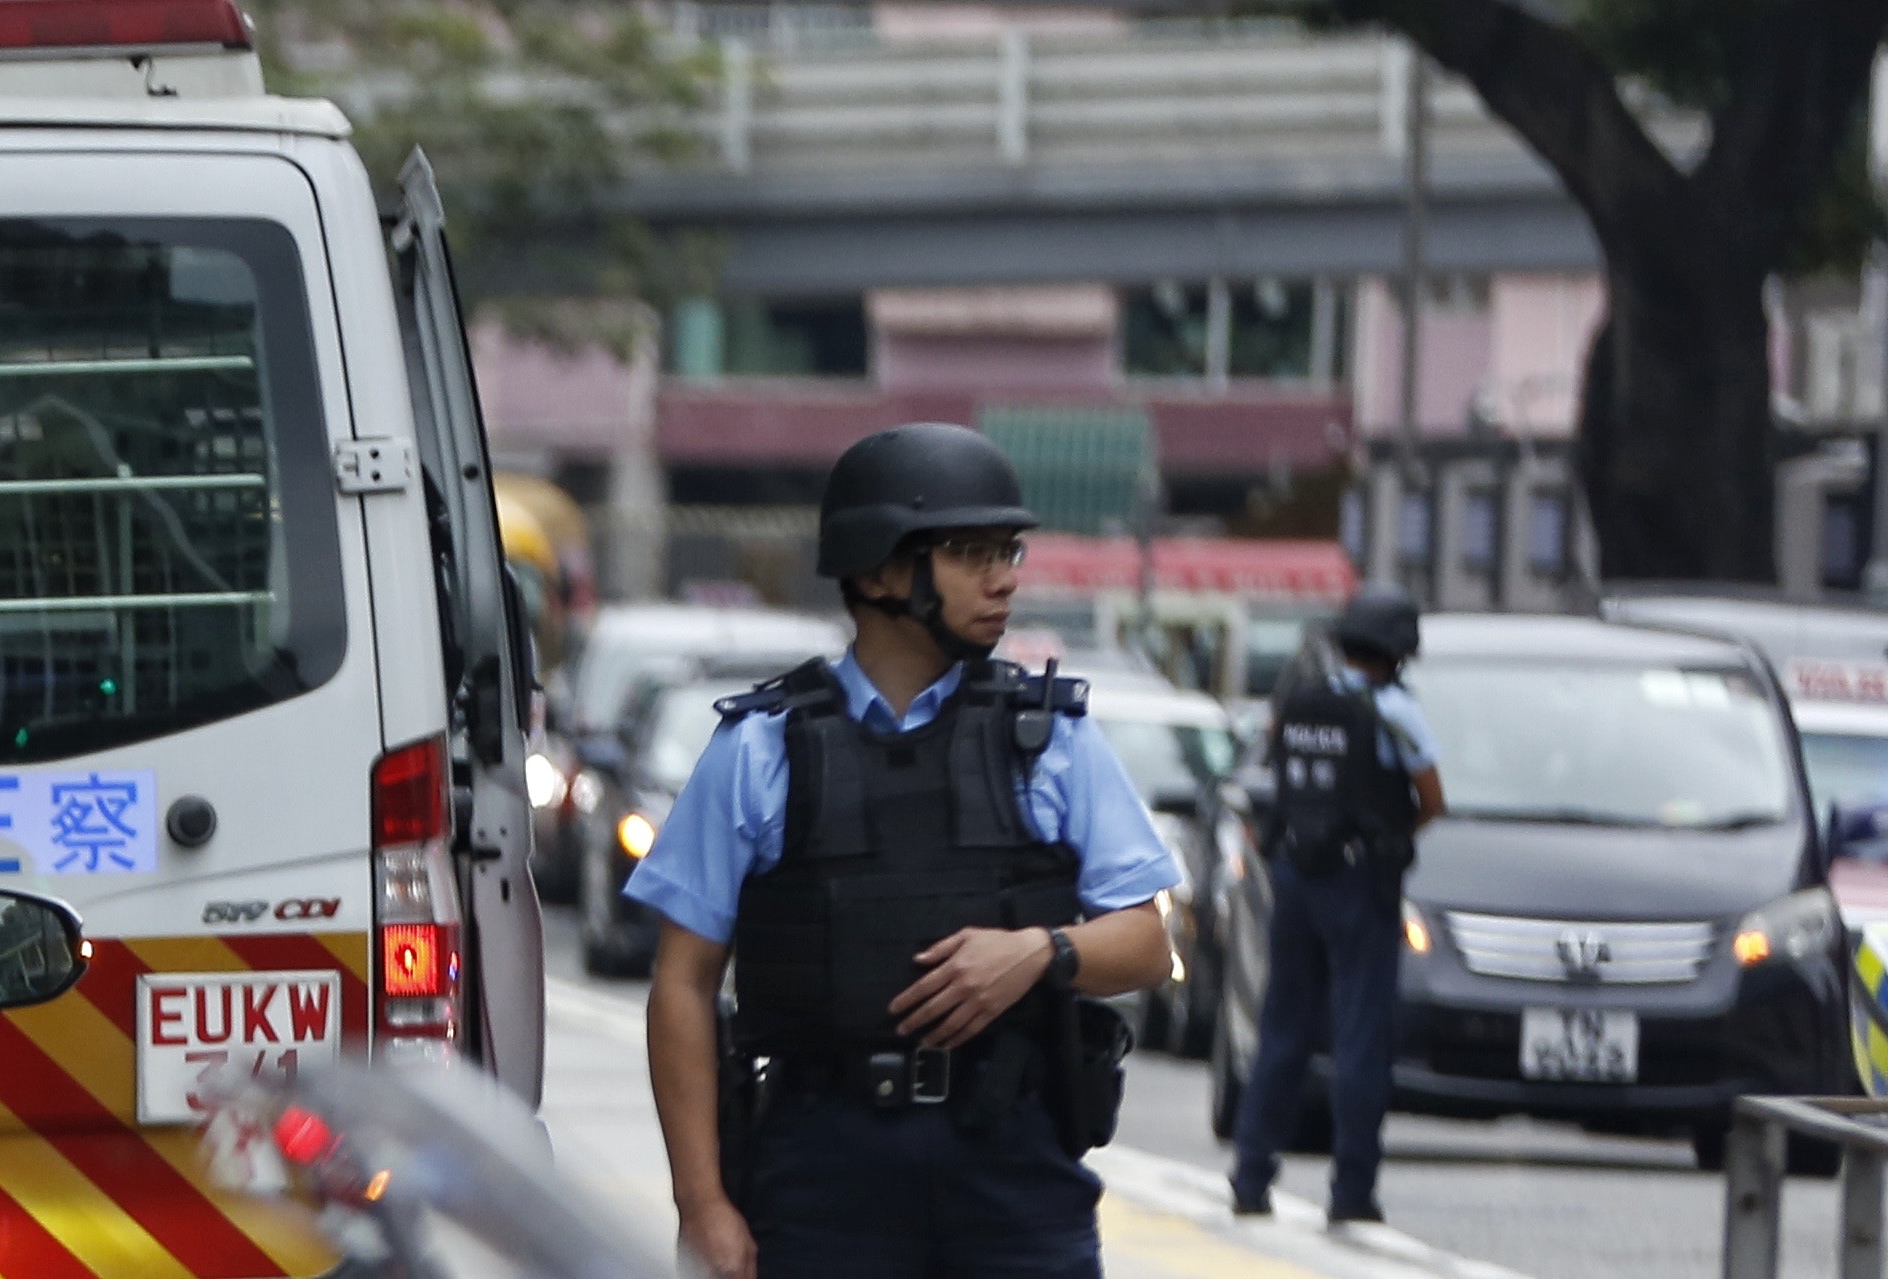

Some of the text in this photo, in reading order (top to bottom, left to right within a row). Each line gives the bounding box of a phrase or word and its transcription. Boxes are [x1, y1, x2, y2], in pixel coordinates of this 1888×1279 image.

[51, 772, 137, 871] 察
[274, 897, 342, 921] CDI
[151, 984, 330, 1046] EUKW
